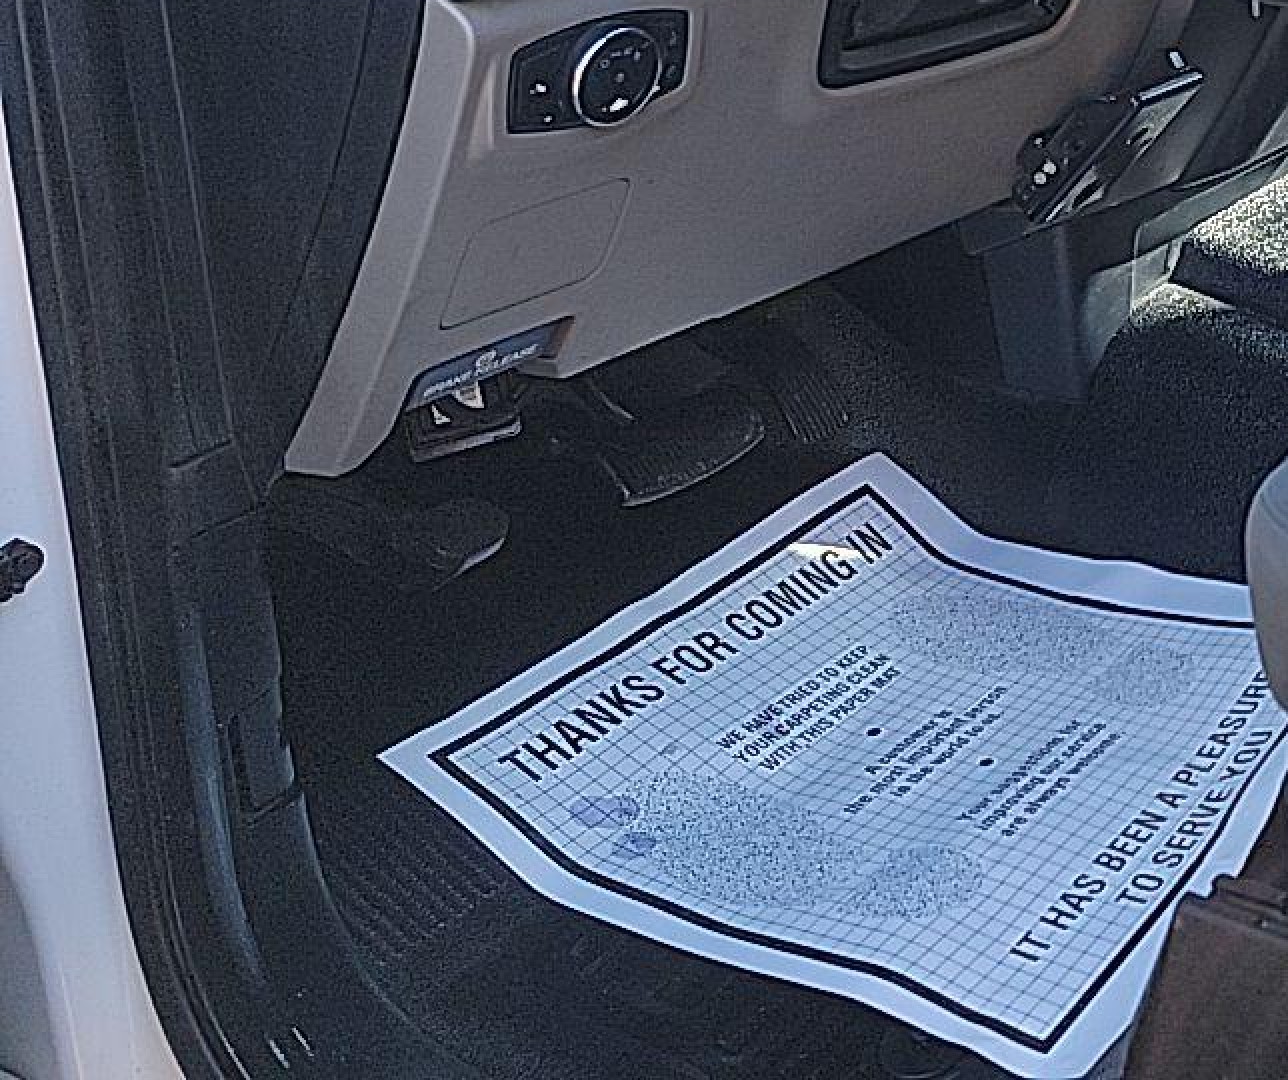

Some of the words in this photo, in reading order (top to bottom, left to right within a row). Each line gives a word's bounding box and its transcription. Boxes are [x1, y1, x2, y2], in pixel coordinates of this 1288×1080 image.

[497, 675, 665, 782] THANKS
[651, 631, 739, 685] FOR
[725, 550, 858, 641] COMING
[846, 521, 893, 565] IN
[715, 729, 746, 750] WE
[742, 703, 785, 734] HAVE
[777, 679, 821, 709] TRIED
[815, 667, 840, 683] TO
[835, 645, 868, 669] KEEP
[732, 731, 781, 763] YOUR
[774, 681, 851, 736] CARPETING
[846, 653, 891, 685] CLEAN
[758, 740, 803, 771] WITH
[799, 717, 835, 743] THIS
[828, 686, 877, 721] PAPER
[1009, 929, 1051, 962] IT
[1039, 873, 1107, 931] HAS
[1092, 809, 1168, 872] BEEN
[1155, 791, 1189, 809] A
[1114, 873, 1165, 905] TO
[1152, 787, 1234, 869] SERVE
[1220, 731, 1273, 781] YOU
